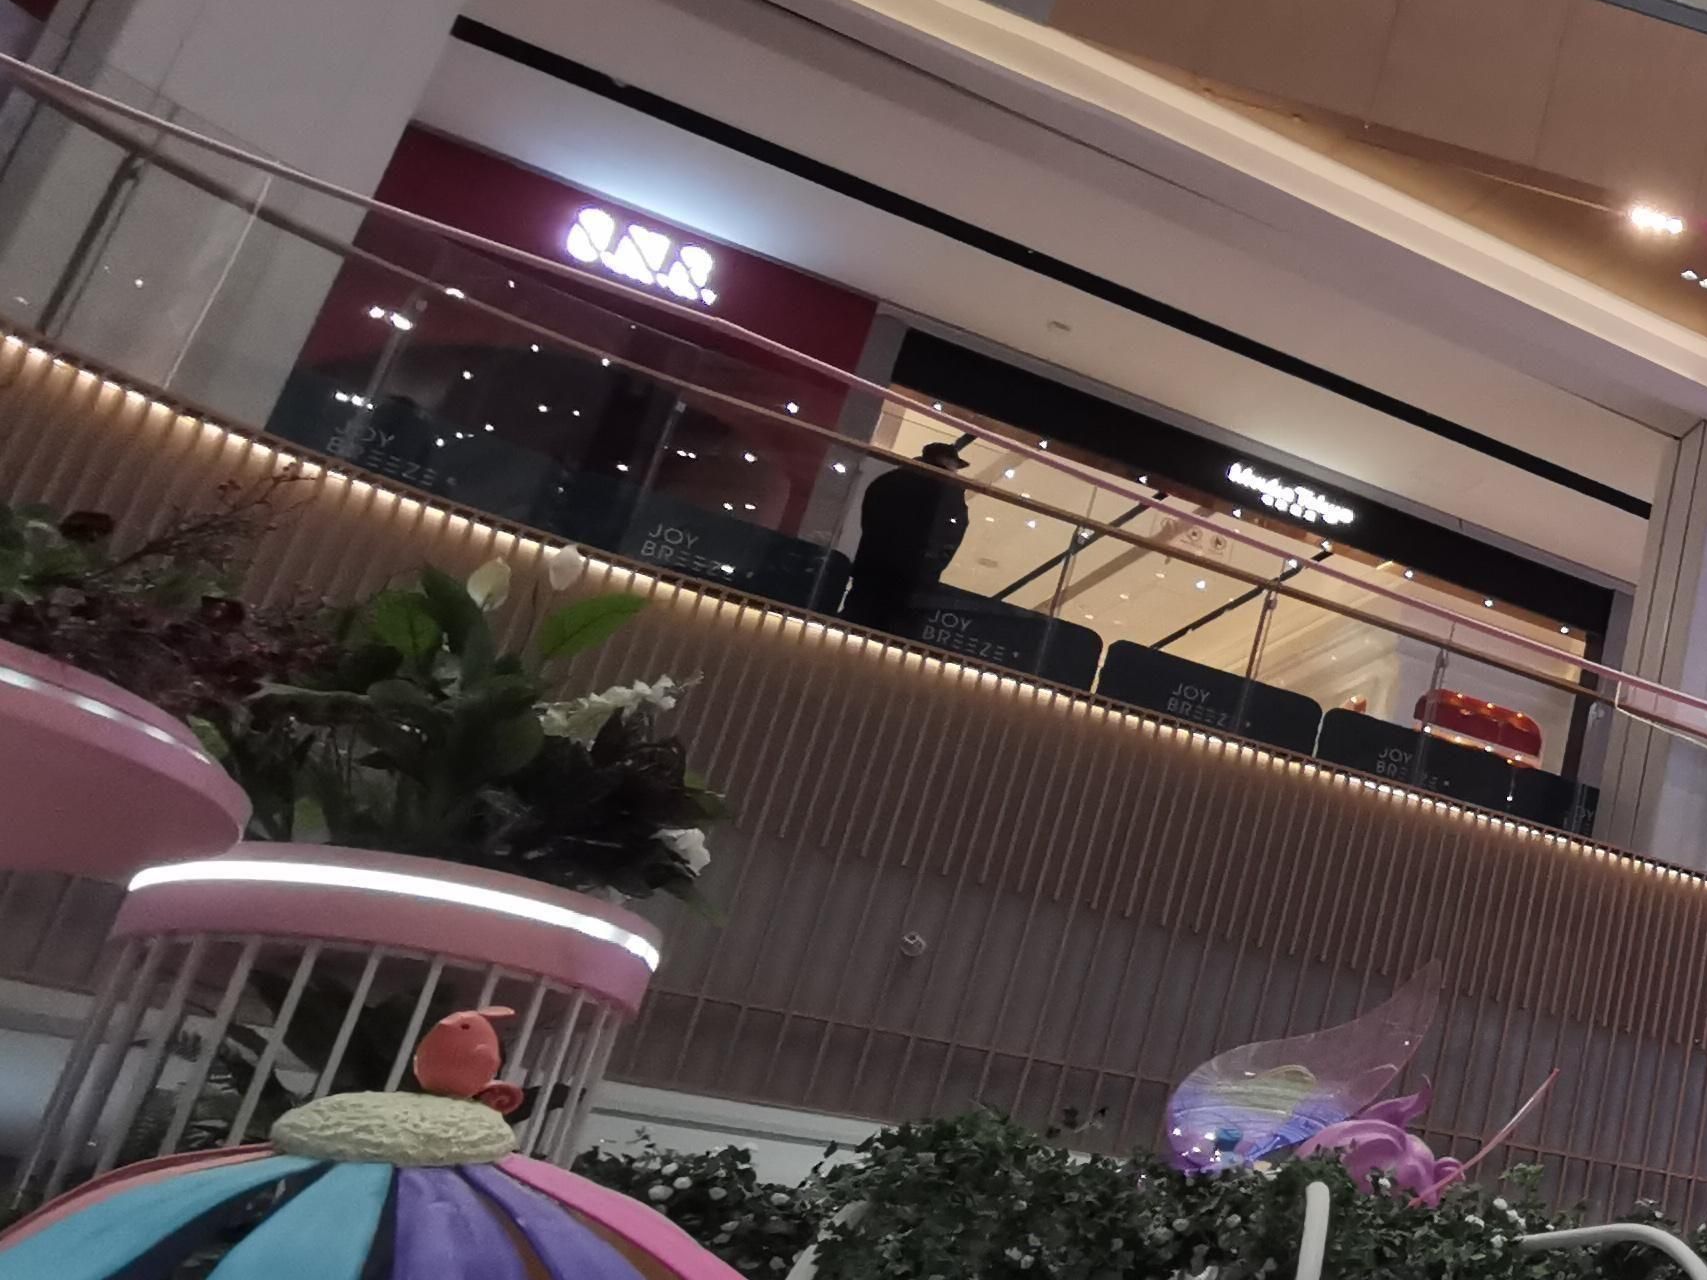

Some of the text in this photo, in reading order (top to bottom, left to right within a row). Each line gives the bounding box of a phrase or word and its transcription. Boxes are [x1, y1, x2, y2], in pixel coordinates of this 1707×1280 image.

[649, 523, 699, 550] JOY
[928, 609, 972, 632] JOY
[921, 624, 1006, 663] BREEZE
[1172, 682, 1211, 704] JOY
[1167, 696, 1232, 728] BREEZ
[1377, 747, 1414, 765] JOY
